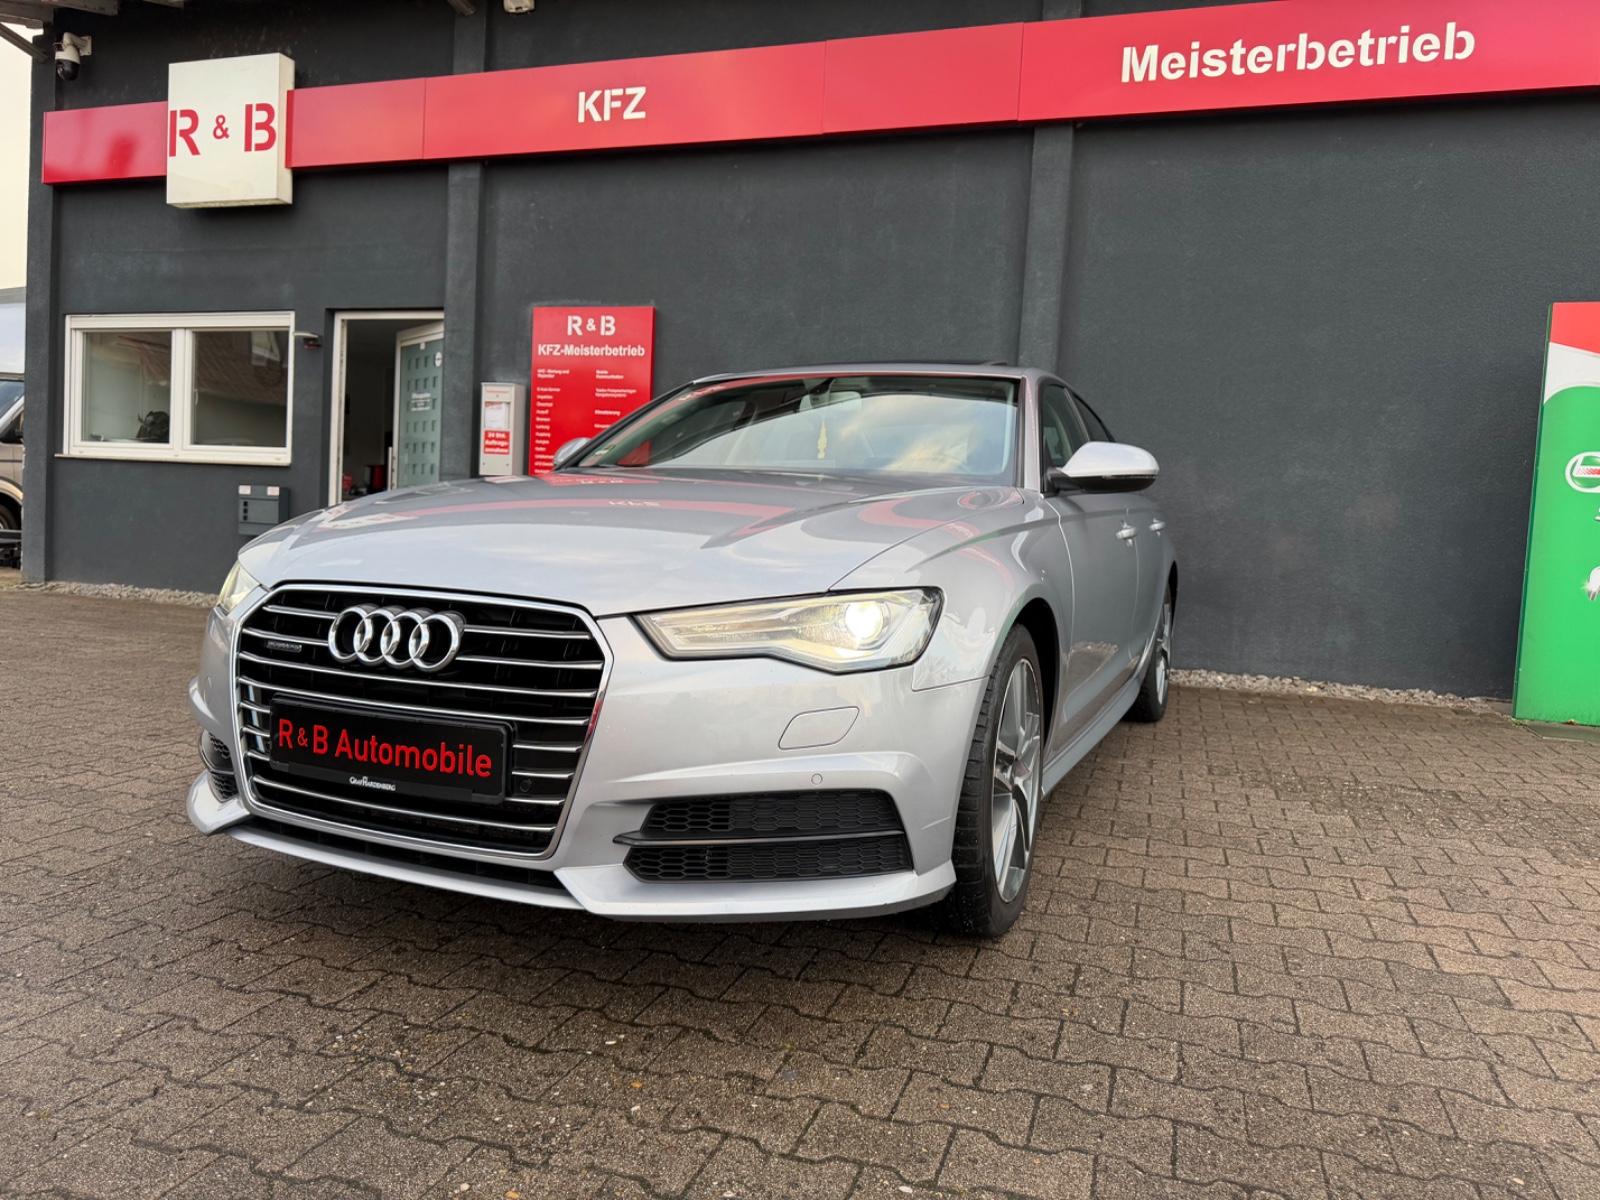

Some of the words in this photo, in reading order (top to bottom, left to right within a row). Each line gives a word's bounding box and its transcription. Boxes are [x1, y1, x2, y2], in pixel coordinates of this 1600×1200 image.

[578, 86, 647, 123] KFZ
[1121, 22, 1476, 83] Meisterbetrieb
[169, 109, 201, 157] R
[213, 115, 230, 139] &
[244, 103, 277, 152] B
[538, 343, 646, 357] KFZ-Meisterbetrieb
[567, 315, 583, 336] R
[586, 318, 596, 331] &
[600, 315, 616, 336] B
[278, 719, 293, 749] R
[297, 728, 308, 747] &
[313, 724, 329, 755] B
[335, 728, 492, 778] Automobile
